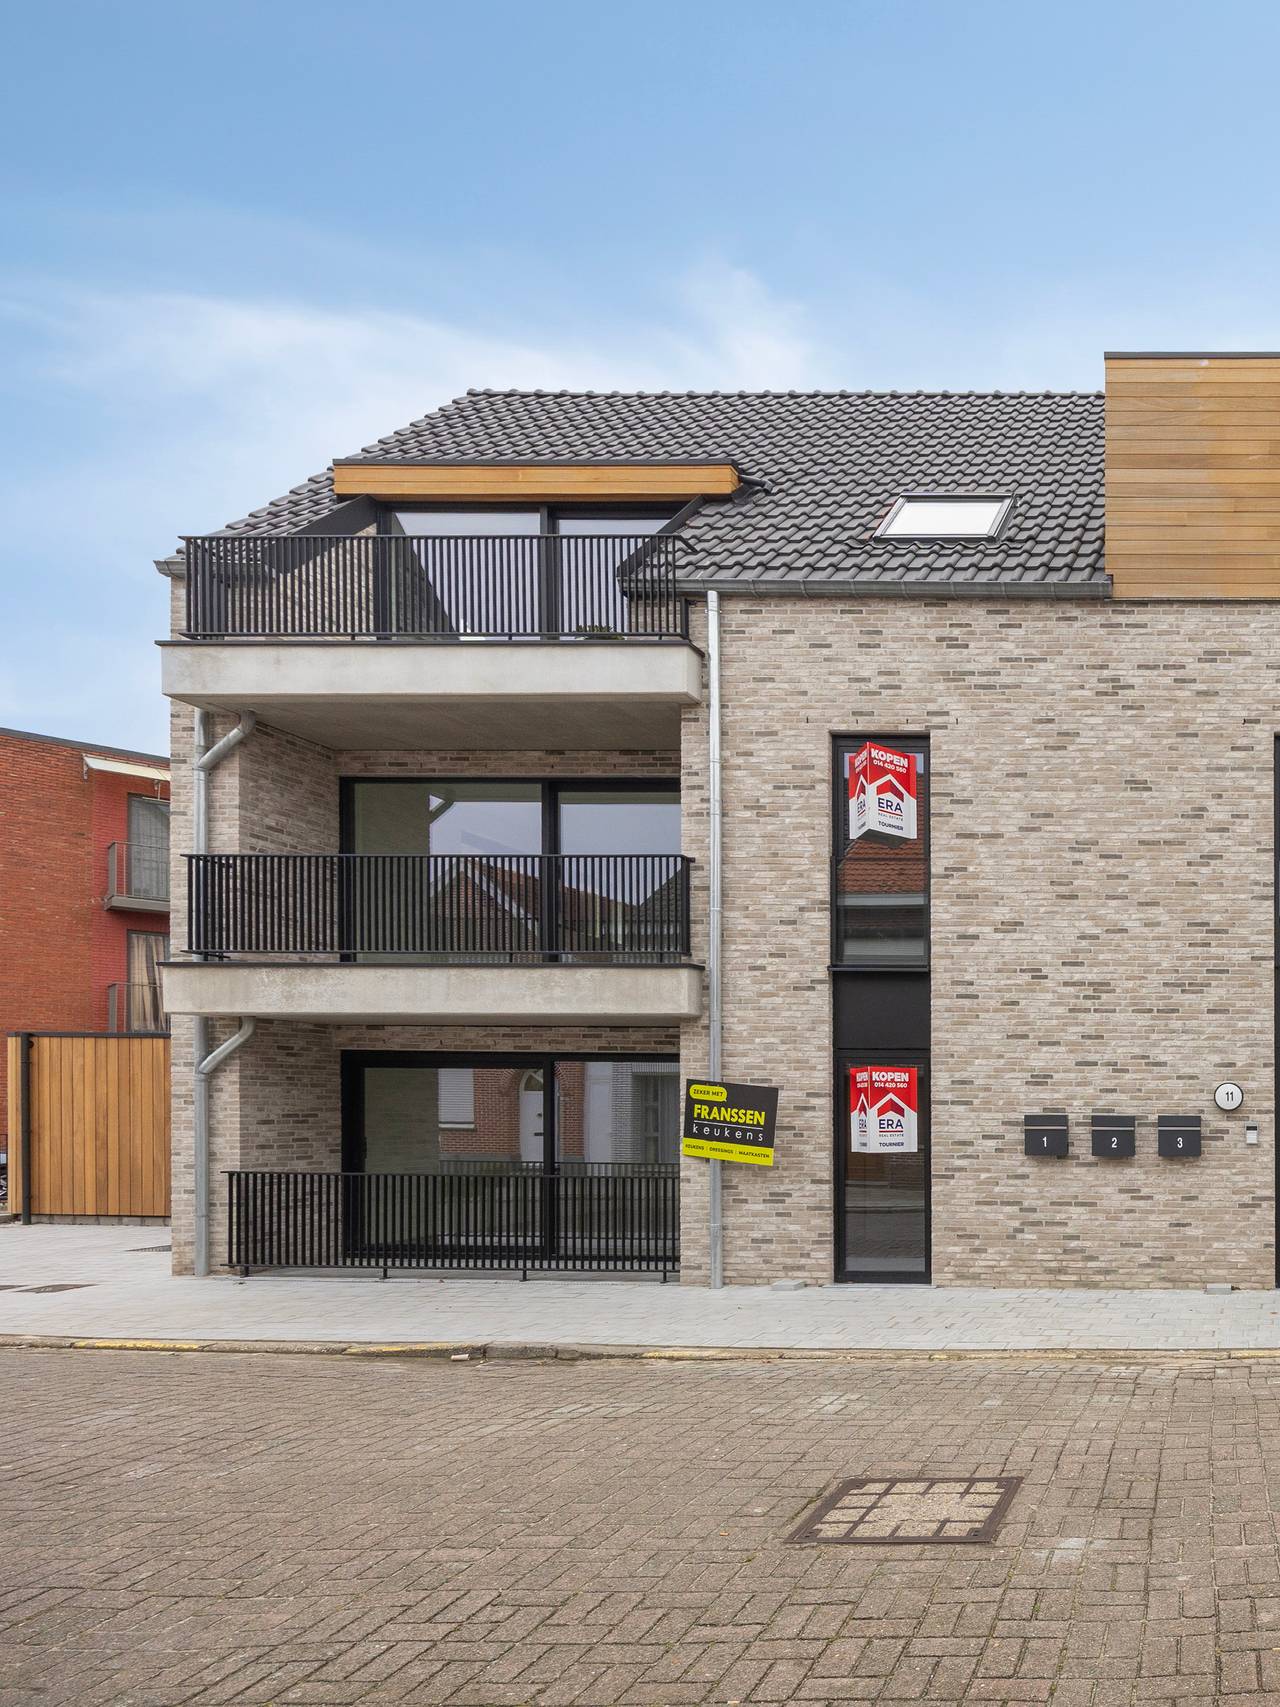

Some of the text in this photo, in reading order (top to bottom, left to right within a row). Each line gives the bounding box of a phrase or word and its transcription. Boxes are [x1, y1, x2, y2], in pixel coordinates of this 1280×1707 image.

[870, 748, 908, 767] KOPEN
[873, 759, 884, 767] 014
[884, 762, 895, 770] 420
[877, 797, 903, 813] ERA
[878, 820, 904, 831] TOURNIER
[871, 1071, 909, 1082] KOPEN
[693, 1088, 710, 1096] ZEKER
[1225, 1091, 1234, 1101] 11
[693, 1103, 766, 1125] FRANSSEN
[878, 1119, 904, 1129] ERA
[692, 1123, 764, 1141] keukens
[1042, 1137, 1047, 1147] 1
[1111, 1137, 1118, 1148] 2
[1177, 1137, 1183, 1148] 3
